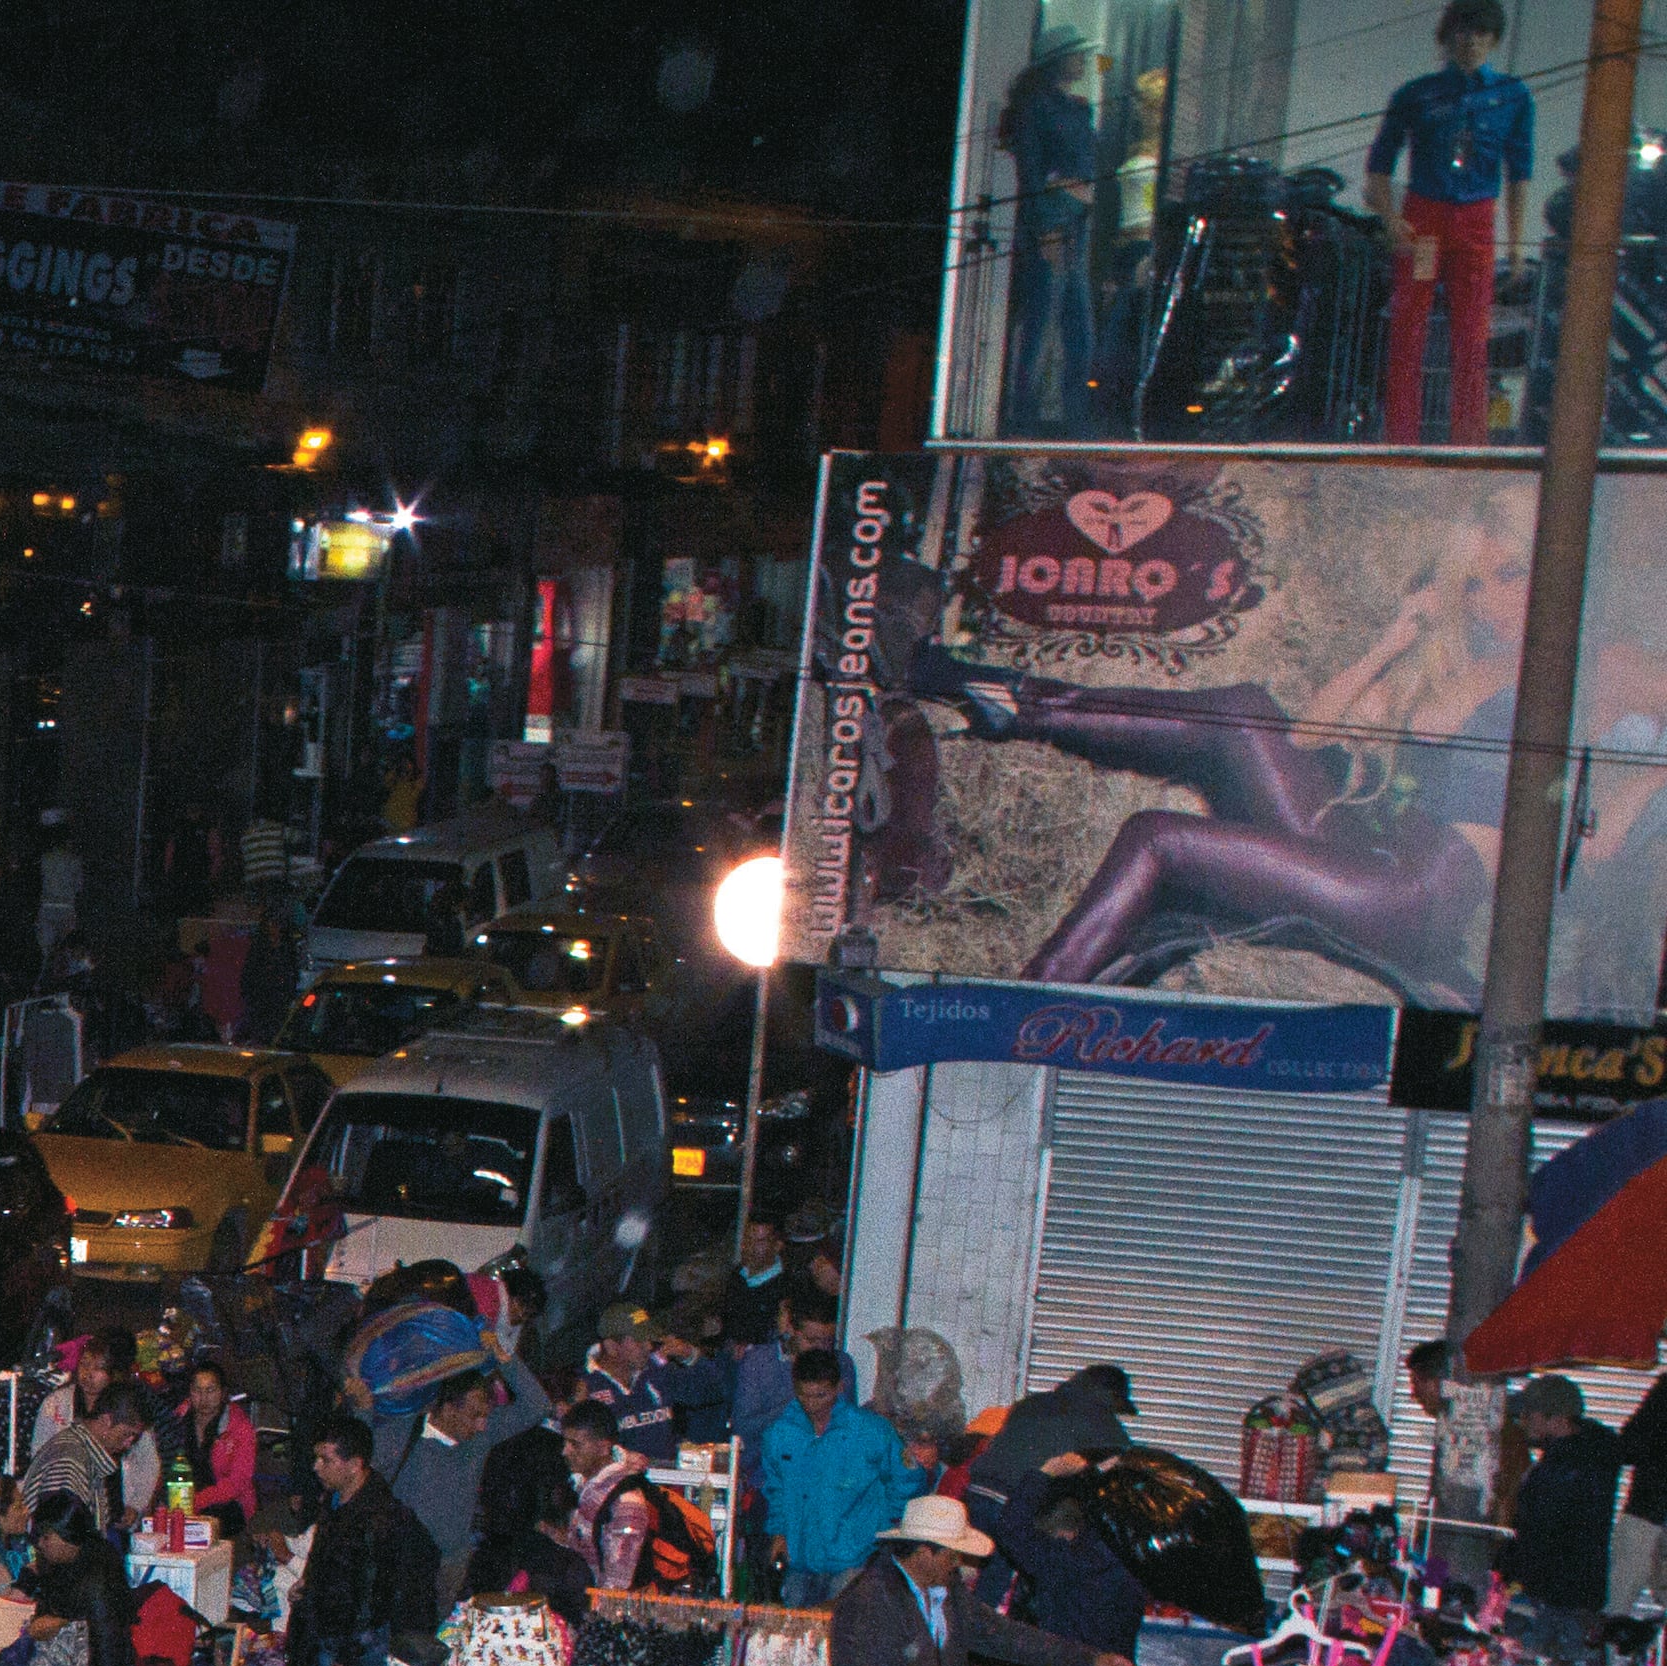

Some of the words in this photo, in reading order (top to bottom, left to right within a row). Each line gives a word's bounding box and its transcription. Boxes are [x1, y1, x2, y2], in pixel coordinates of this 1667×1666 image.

[161, 242, 281, 286] DESDE
[899, 998, 990, 1022] Tejidos
[1014, 1005, 1274, 1068] Richard
